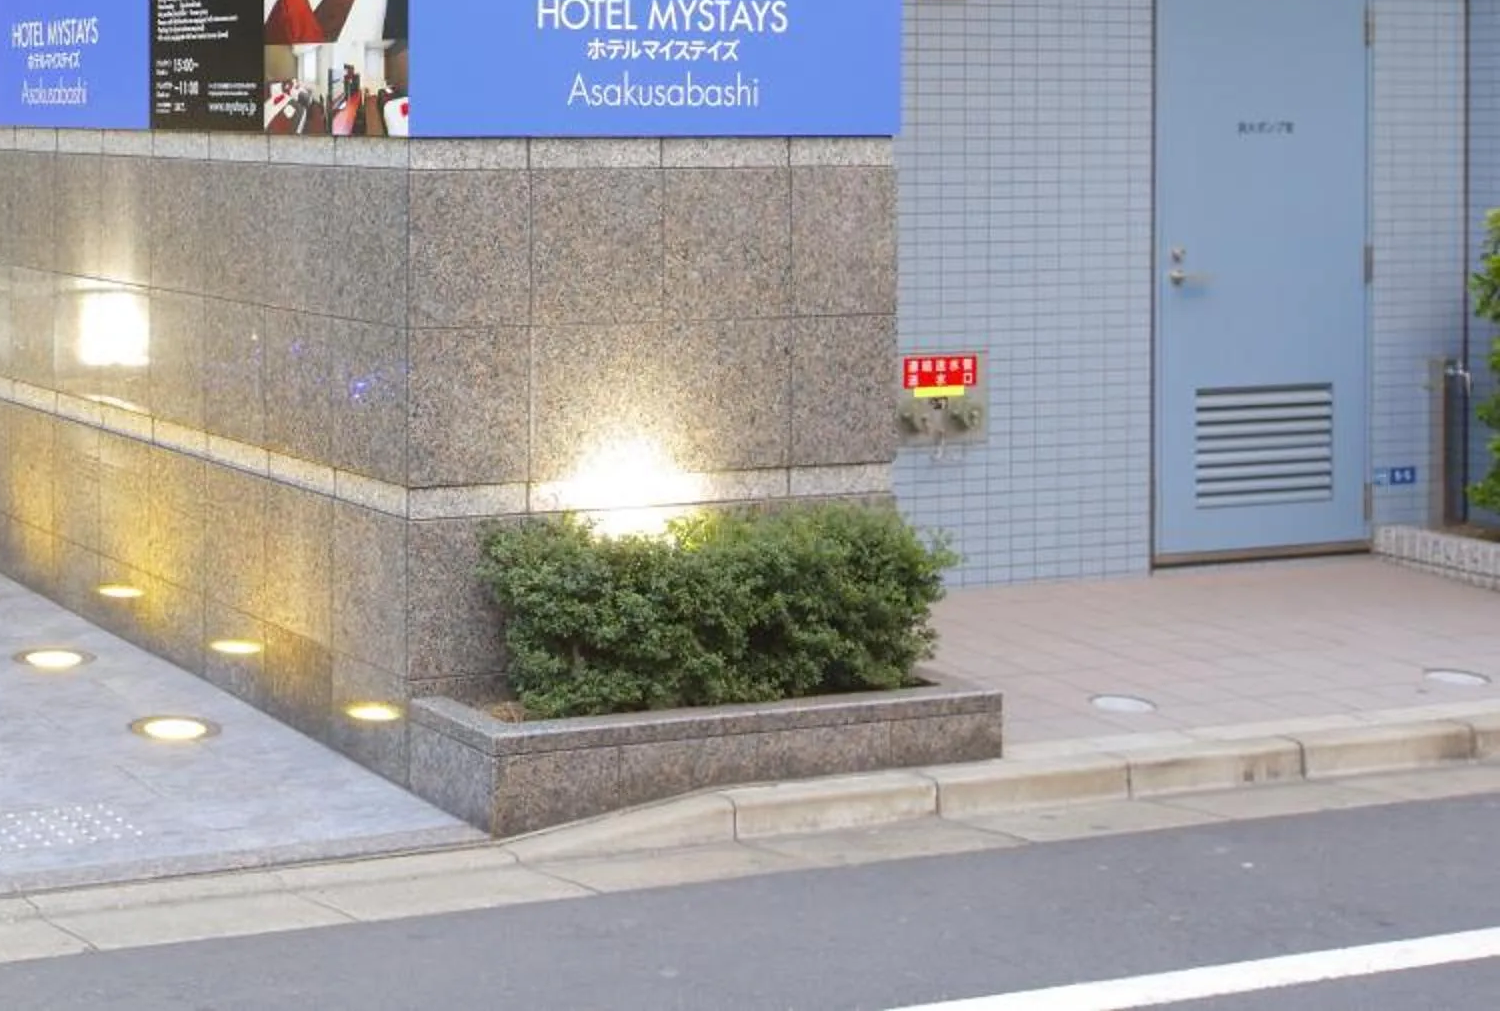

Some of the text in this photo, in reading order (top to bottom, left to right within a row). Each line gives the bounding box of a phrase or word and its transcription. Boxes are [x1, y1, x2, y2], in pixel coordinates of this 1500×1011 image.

[12, 17, 99, 48] HOTEL MYSTAYS
[587, 39, 741, 61] ホテルマイステイズ
[22, 77, 87, 104] Asakusabashi
[567, 71, 759, 107] Asakusabashi
